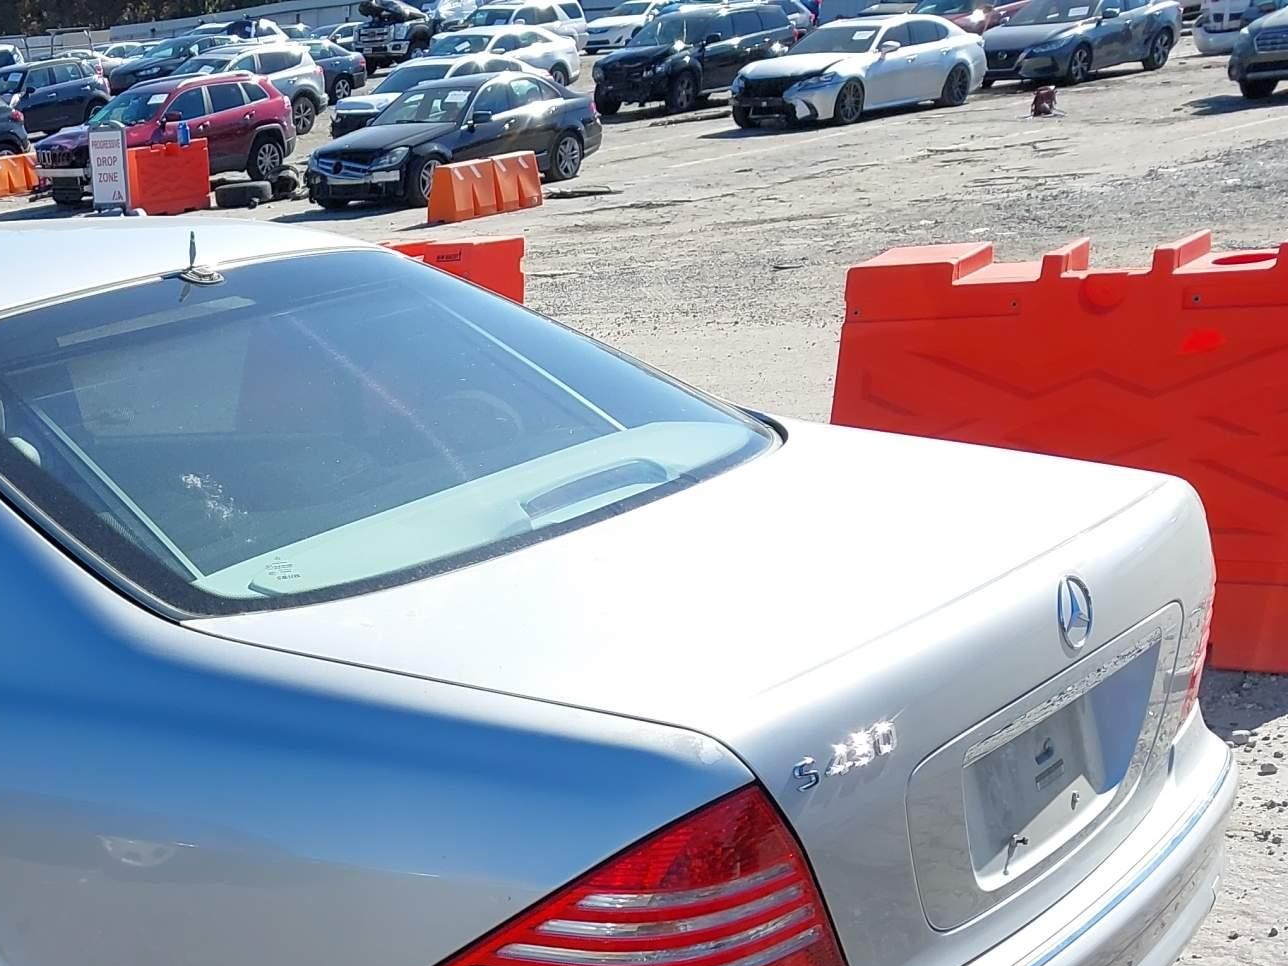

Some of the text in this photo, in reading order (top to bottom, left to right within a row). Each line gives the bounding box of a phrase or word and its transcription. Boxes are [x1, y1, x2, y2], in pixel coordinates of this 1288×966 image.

[96, 155, 118, 167] DROP
[97, 171, 119, 183] ZONE
[793, 756, 820, 792] S
